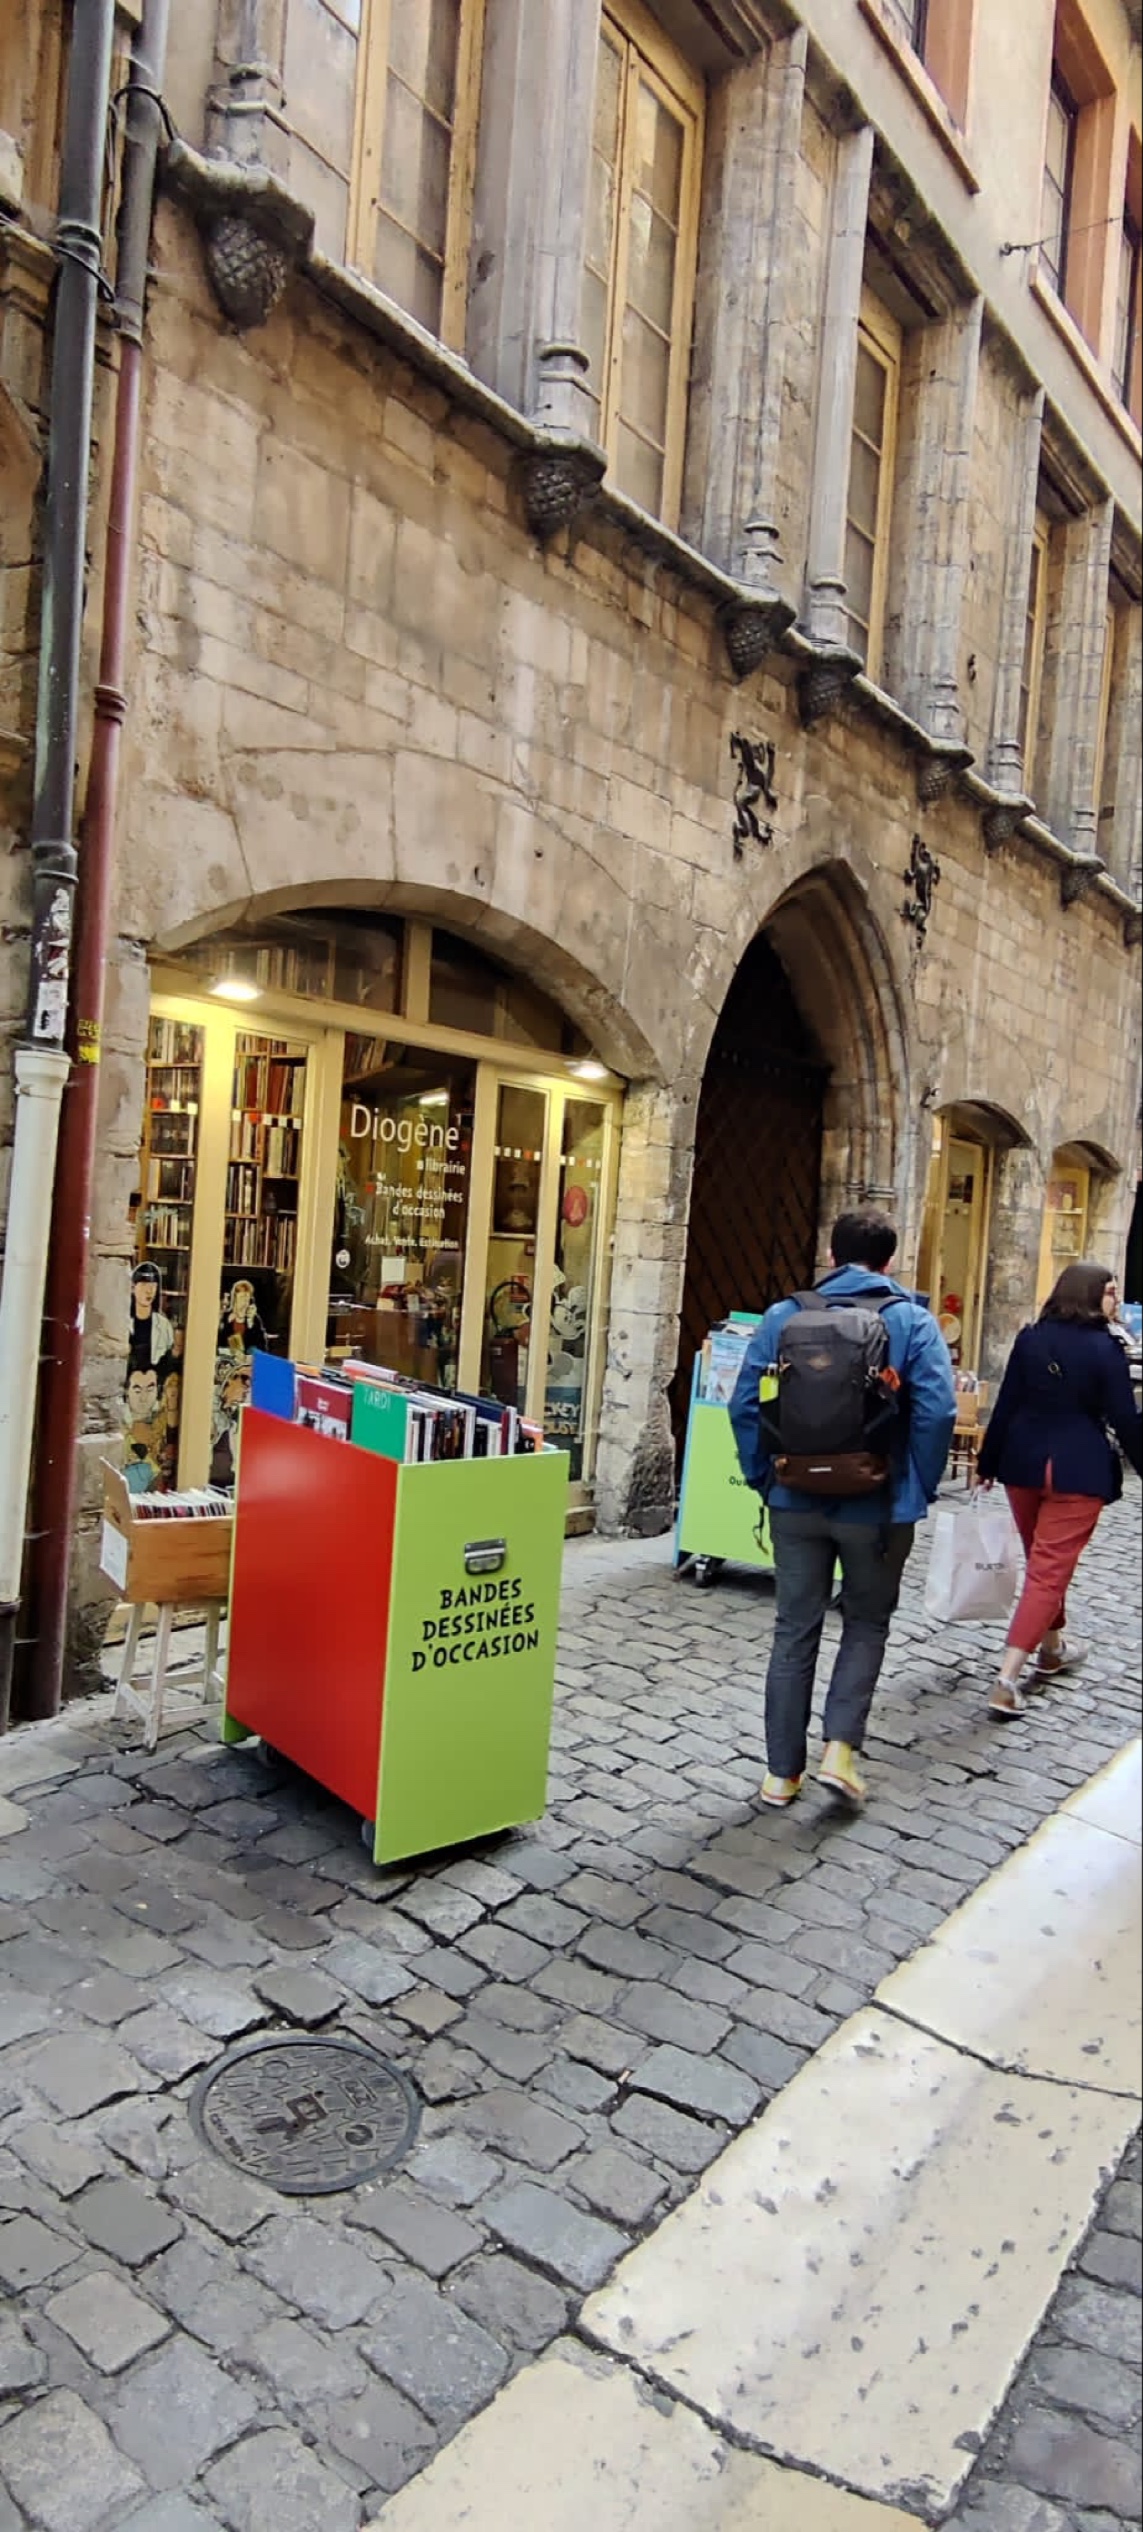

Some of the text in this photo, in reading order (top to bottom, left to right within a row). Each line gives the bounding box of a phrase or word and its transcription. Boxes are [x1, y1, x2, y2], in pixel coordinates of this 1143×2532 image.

[350, 1103, 460, 1152] Diogène
[425, 1157, 466, 1175] librairie
[375, 1181, 463, 1203] Bandes dessinées
[392, 1199, 446, 1219] d'occasion
[440, 1578, 522, 1610] BANDES
[422, 1602, 535, 1641] DESSINÉES
[411, 1629, 539, 1672] D'OCCASION
